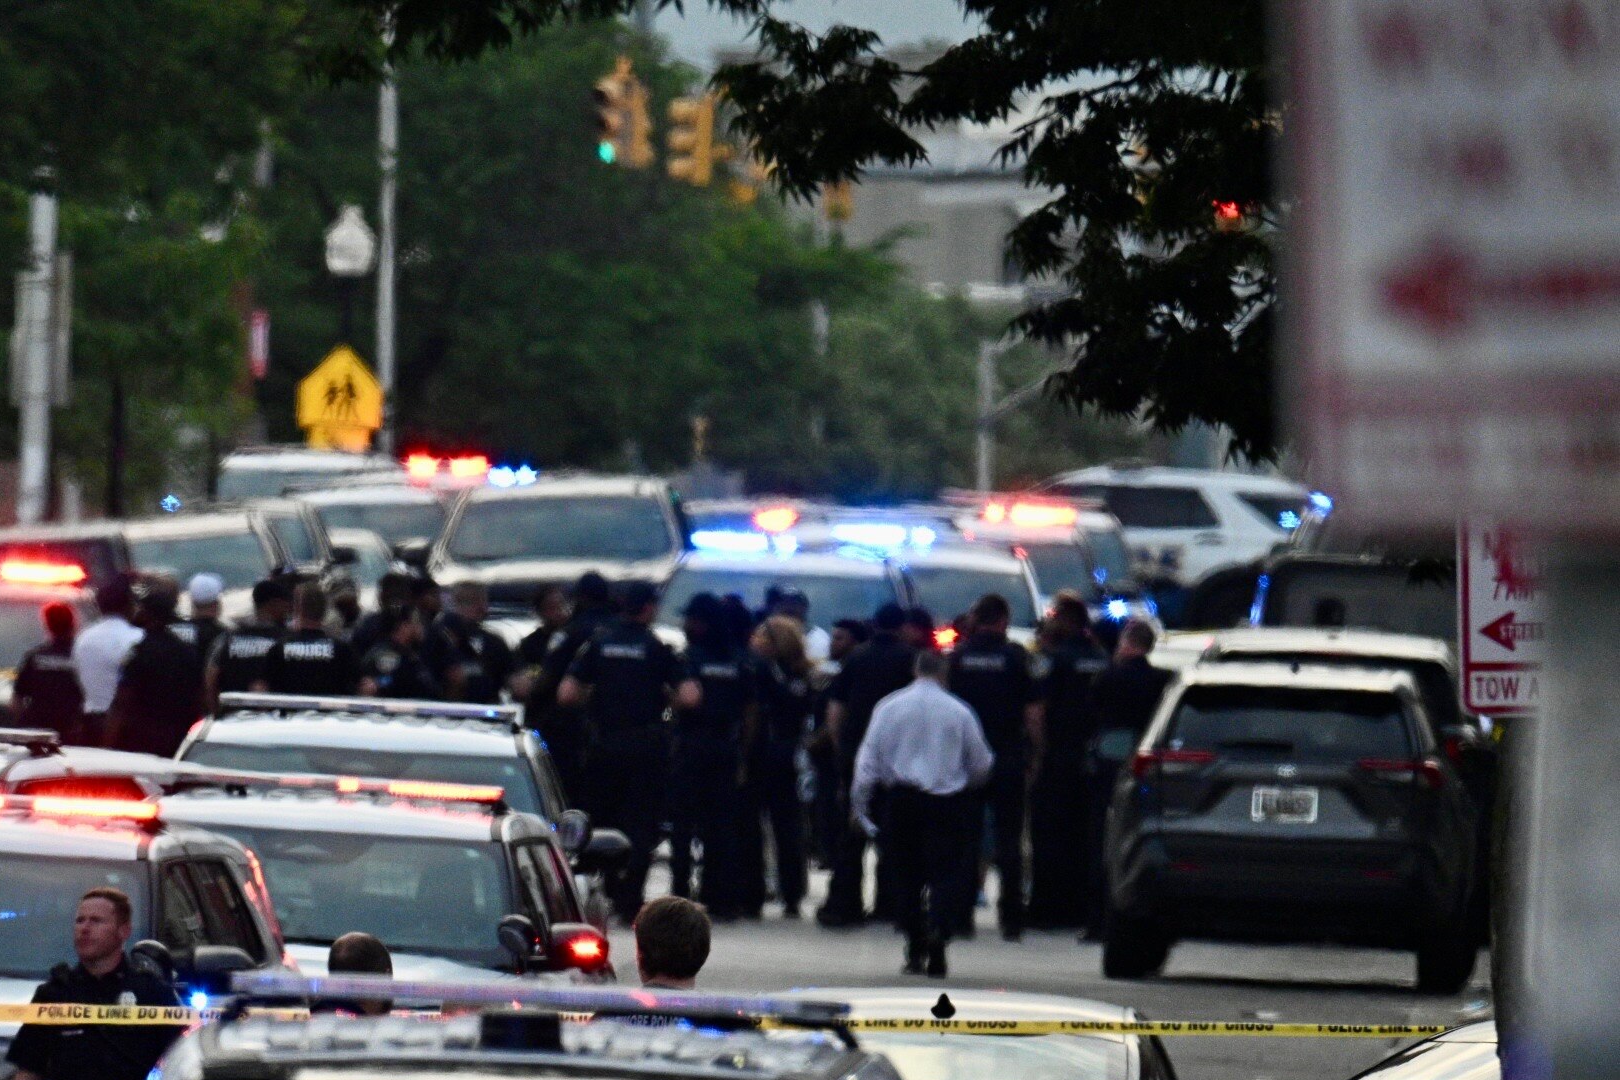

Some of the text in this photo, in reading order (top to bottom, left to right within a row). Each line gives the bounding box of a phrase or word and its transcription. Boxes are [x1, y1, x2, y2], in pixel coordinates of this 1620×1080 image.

[283, 640, 335, 660] POLICE
[1475, 676, 1519, 700] TOW
[36, 1005, 91, 1019] POLICE
[96, 1005, 131, 1019] LINE
[137, 1006, 159, 1020] DO
[163, 1007, 192, 1020] NOT
